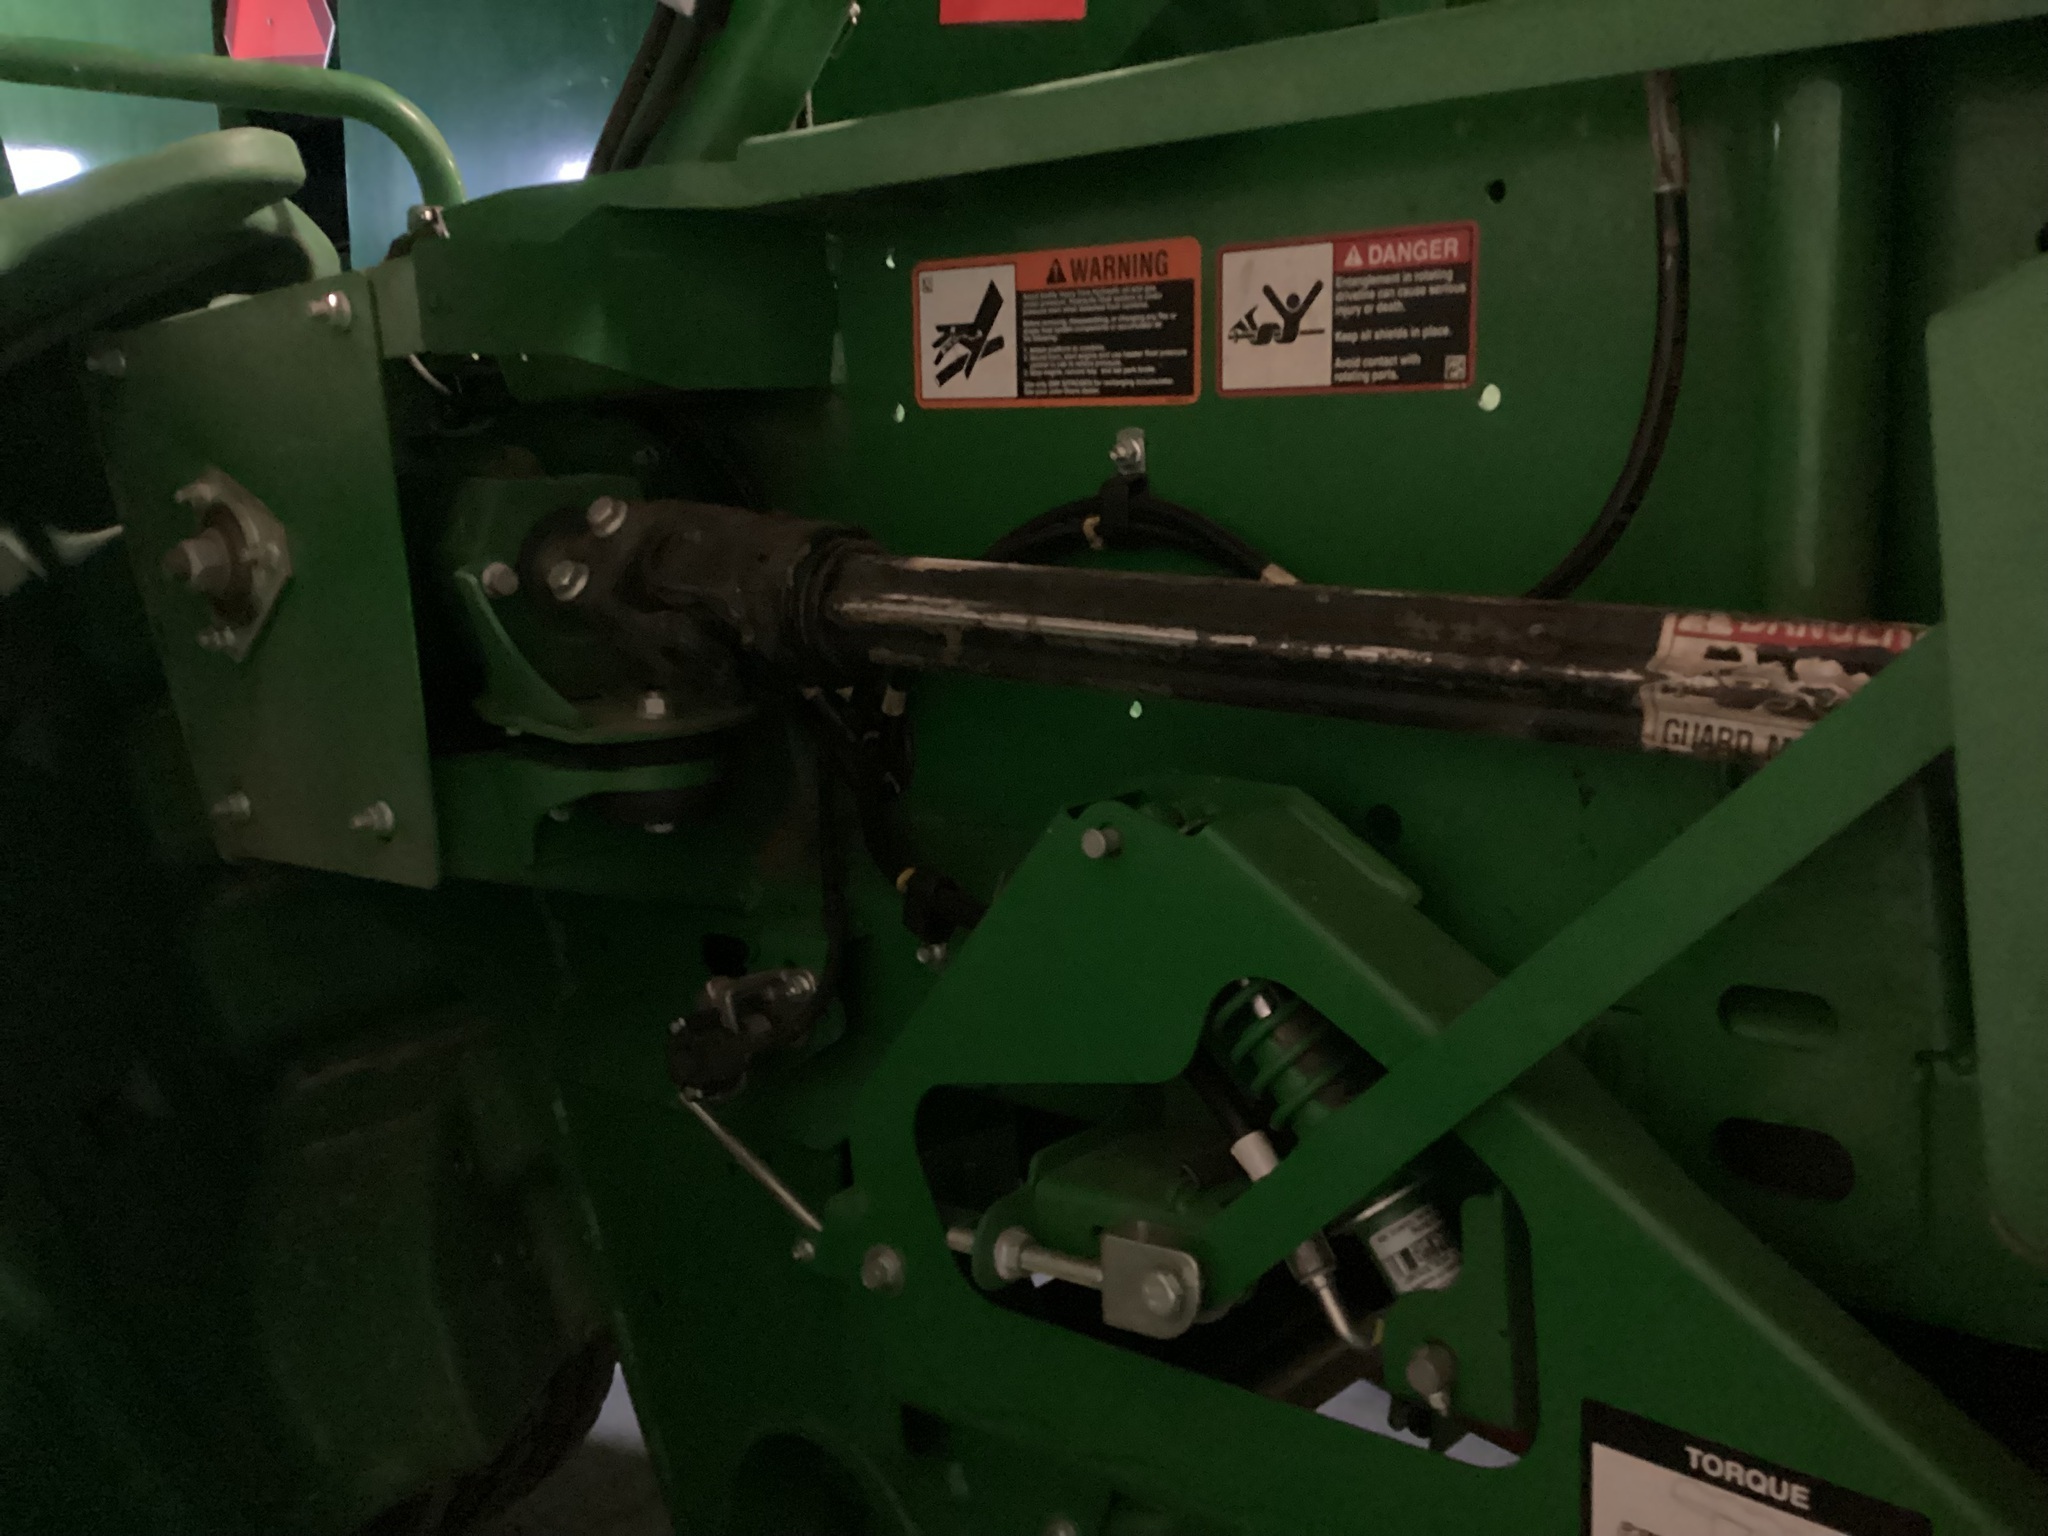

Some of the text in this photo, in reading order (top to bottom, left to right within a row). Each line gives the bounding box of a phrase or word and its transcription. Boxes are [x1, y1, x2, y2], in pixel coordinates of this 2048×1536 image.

[1070, 249, 1169, 282] WARNING
[1368, 237, 1459, 265] DANGER
[1684, 1445, 1811, 1511] TORQUE
